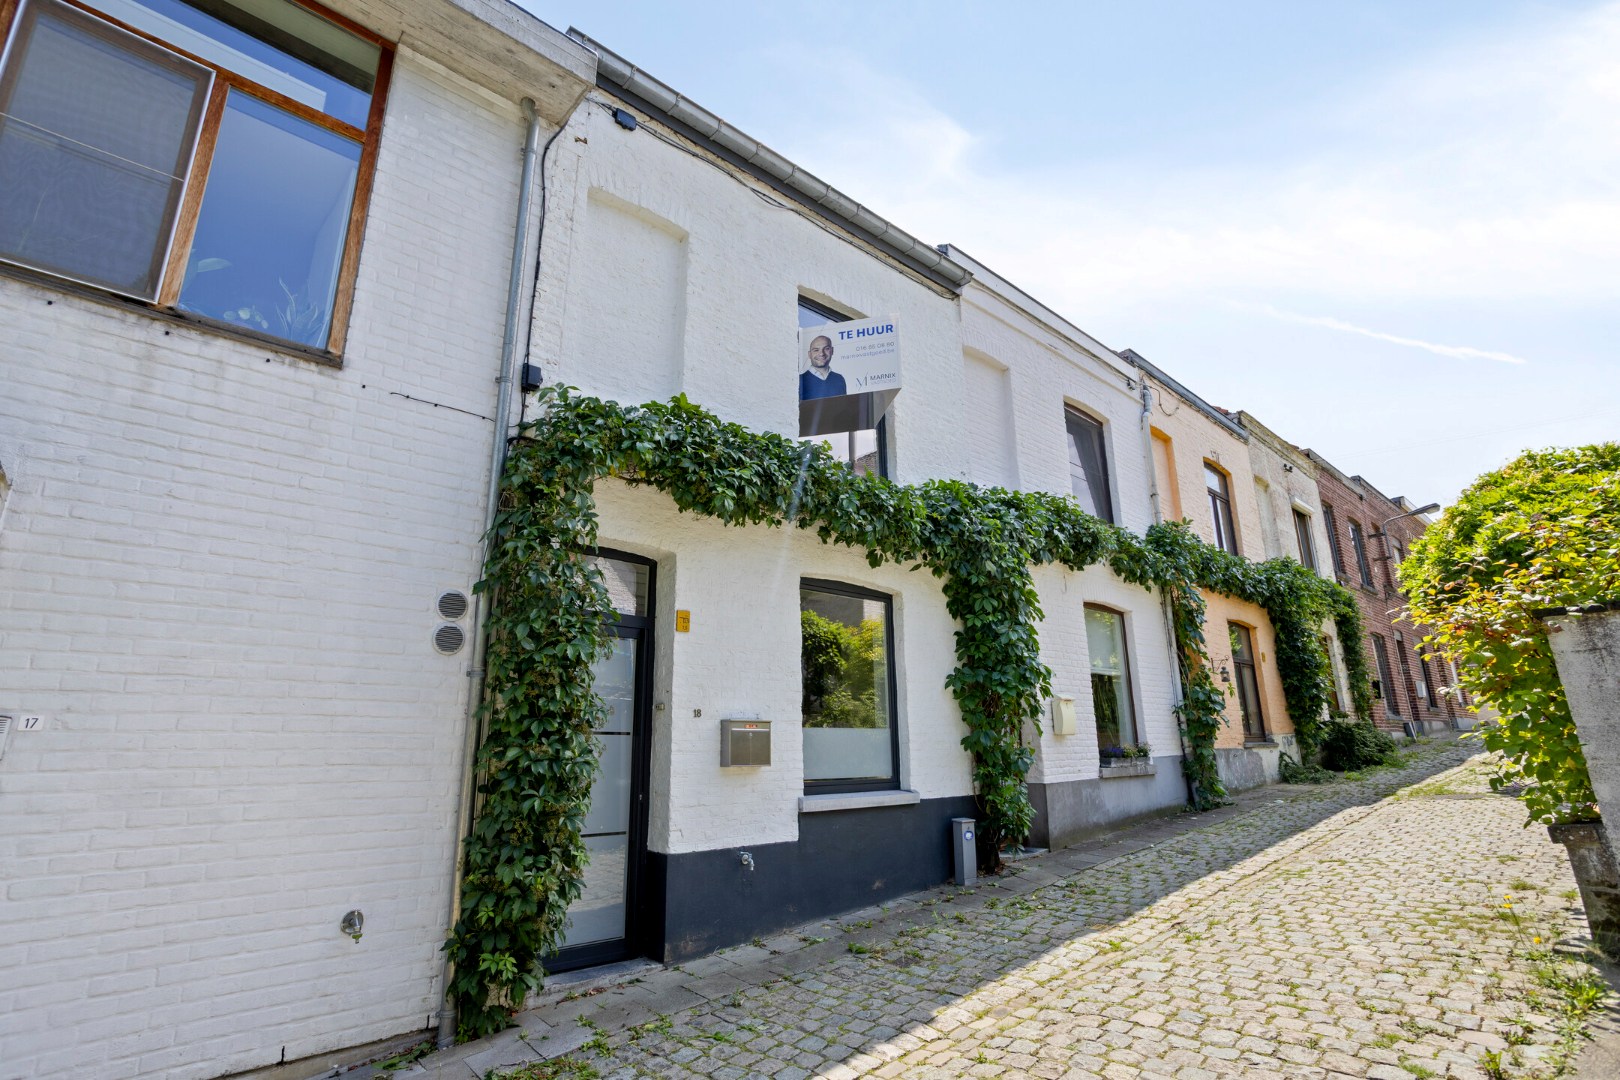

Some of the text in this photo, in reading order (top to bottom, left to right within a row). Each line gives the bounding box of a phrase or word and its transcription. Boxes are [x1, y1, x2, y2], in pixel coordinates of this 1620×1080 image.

[838, 324, 894, 340] TE HUUR
[870, 372, 896, 380] MARNIX
[693, 708, 702, 718] 18
[25, 717, 39, 729] 17
